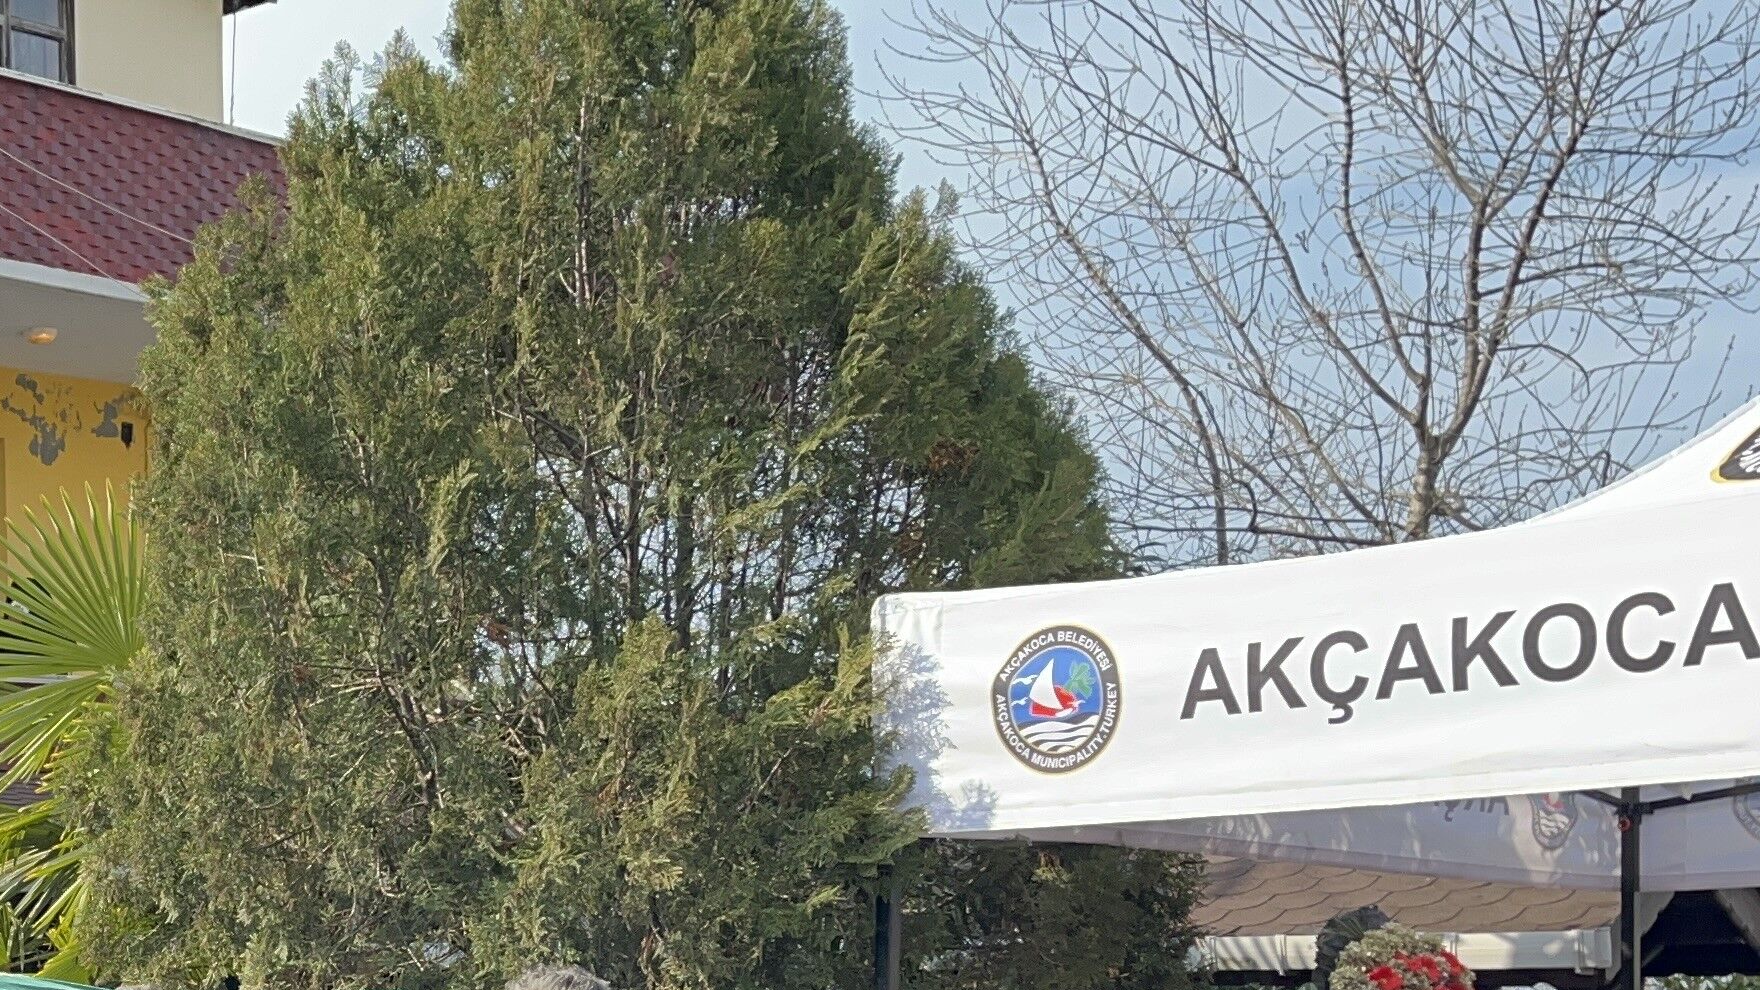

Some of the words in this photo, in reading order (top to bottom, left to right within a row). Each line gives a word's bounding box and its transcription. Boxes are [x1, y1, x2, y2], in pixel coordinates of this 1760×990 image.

[999, 632, 1055, 682] AKÇAKOCA
[1057, 631, 1112, 671] BELEDİYESİ
[1180, 582, 1760, 725] AKÇAKOCA
[996, 694, 1031, 759] AKÇAKOCA
